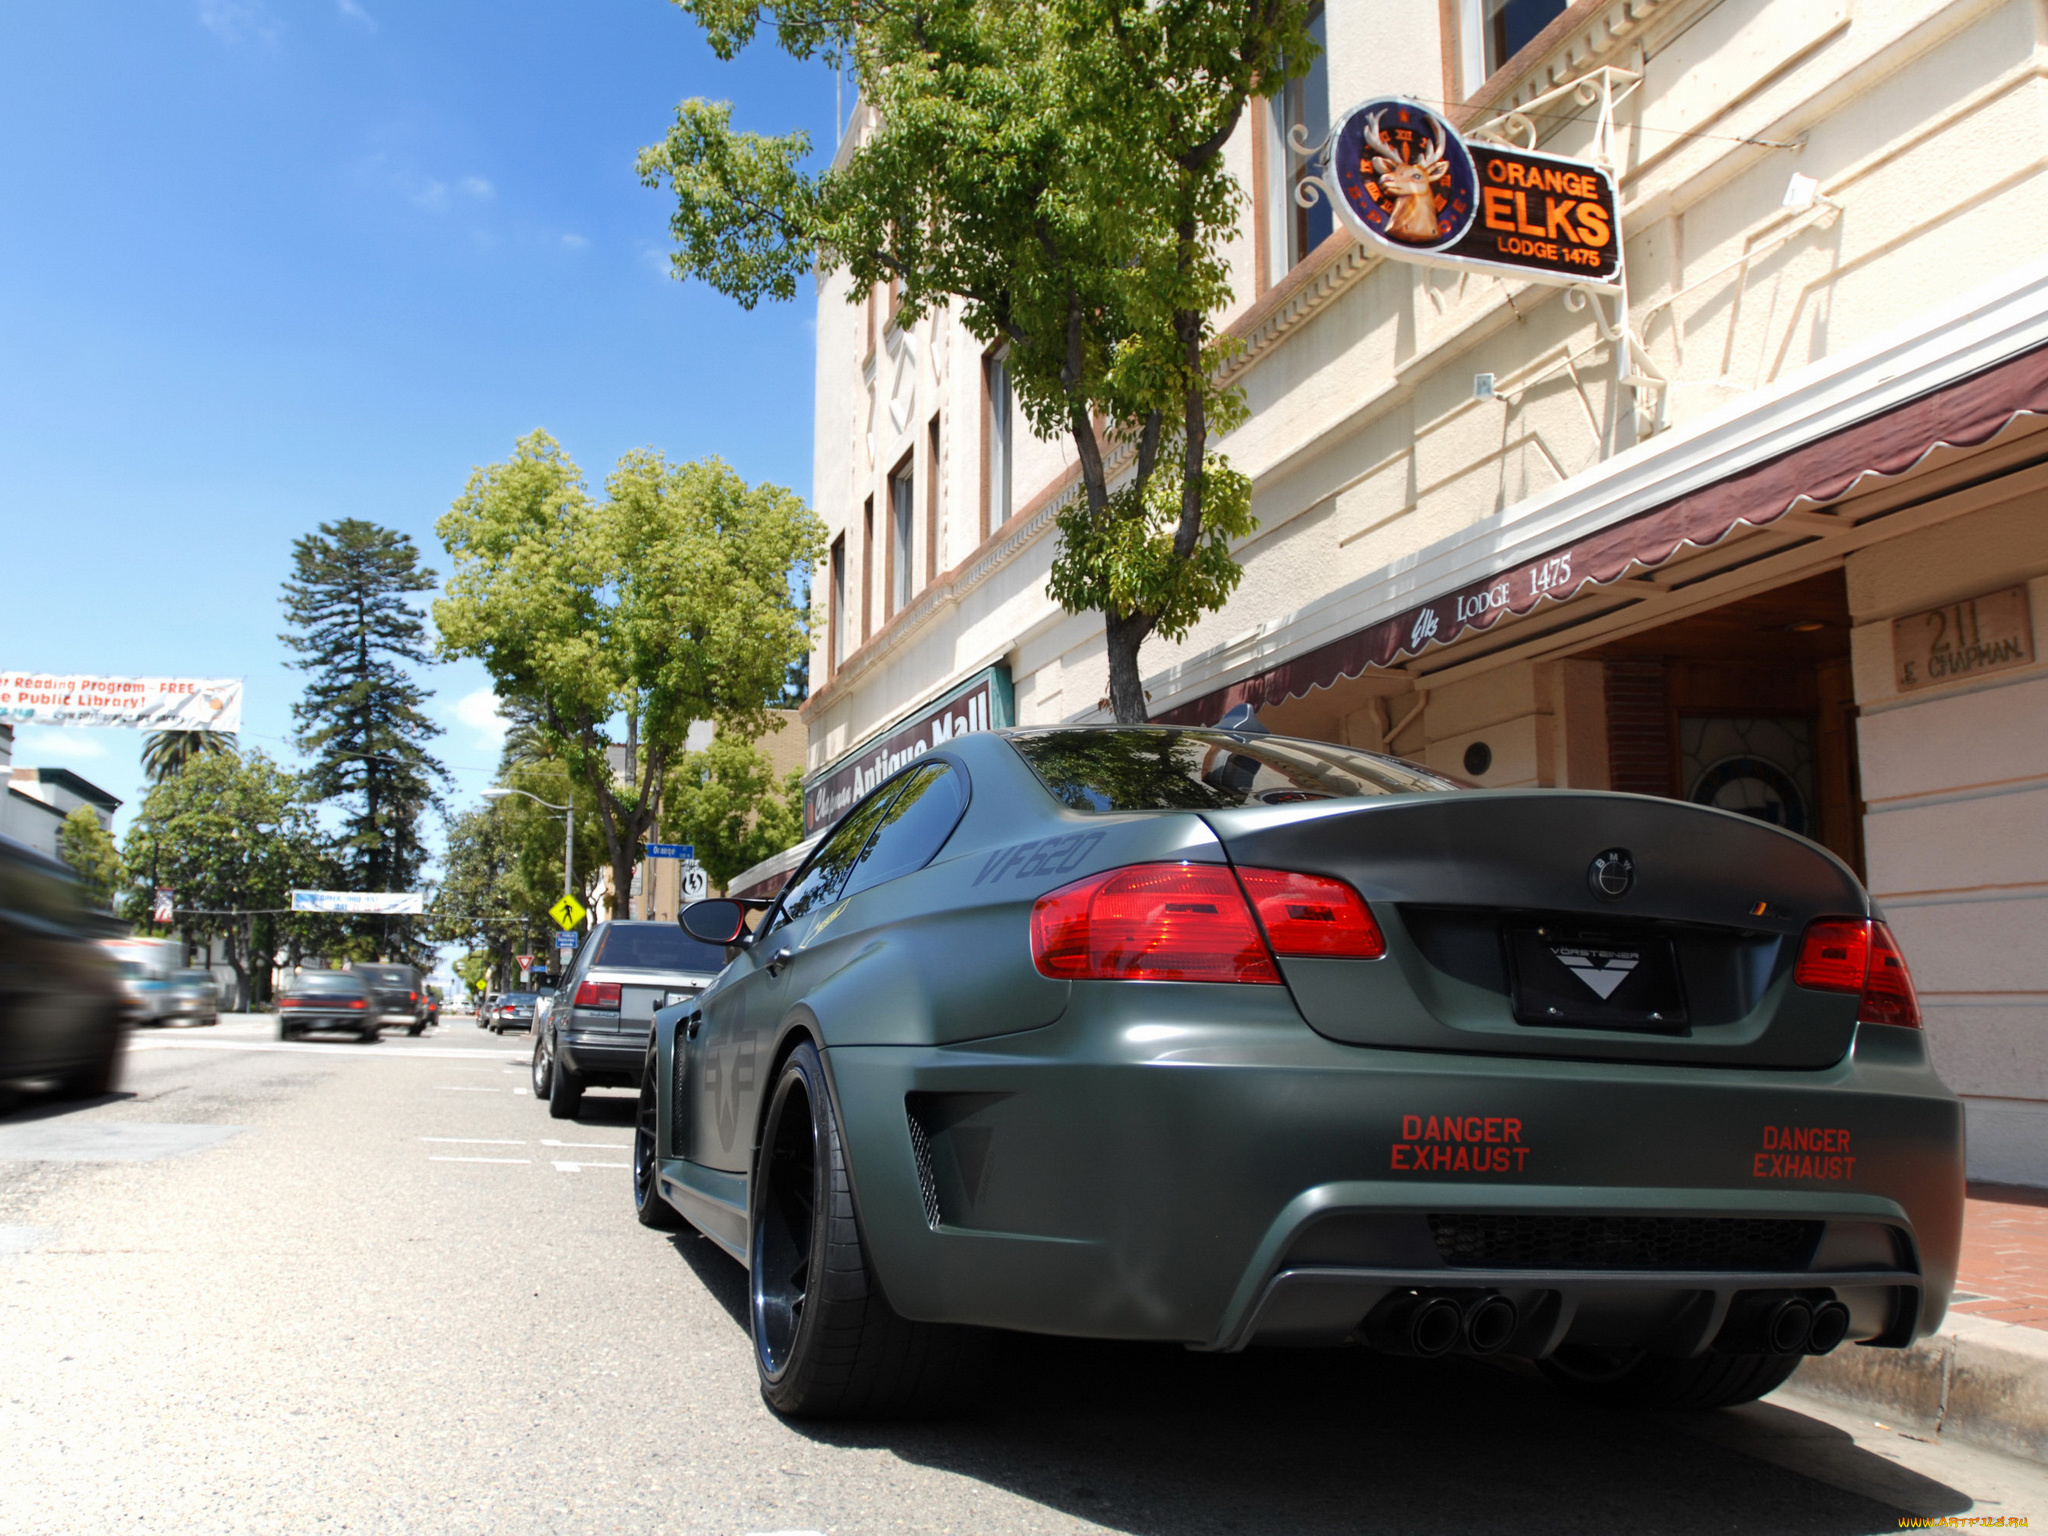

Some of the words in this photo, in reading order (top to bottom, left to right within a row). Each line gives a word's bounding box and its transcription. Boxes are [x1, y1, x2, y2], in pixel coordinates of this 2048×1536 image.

[1487, 159, 1598, 200] ORANGE
[1484, 186, 1610, 247] ELKS
[1497, 236, 1558, 260] LODGE
[1562, 247, 1601, 267] 1475
[1411, 608, 1439, 648] Elks
[1457, 582, 1511, 622] LODGE
[1529, 551, 1572, 596] 1475
[1926, 600, 1980, 653] 211
[1928, 636, 2024, 678] CHAPMAN
[15, 677, 76, 693] Reading
[81, 680, 145, 695] Program
[160, 682, 195, 694] FREE
[18, 692, 71, 706] Public
[78, 694, 145, 709] Library!
[932, 690, 987, 747] Mall
[653, 845, 676, 858] Orange
[971, 831, 1107, 888] VF620
[1595, 853, 1632, 870] BMW
[1402, 1114, 1522, 1143] DANGER
[1763, 1125, 1851, 1153] DANGER
[1391, 1144, 1530, 1172] EXHAUST
[1753, 1153, 1857, 1180] EXHAUST
